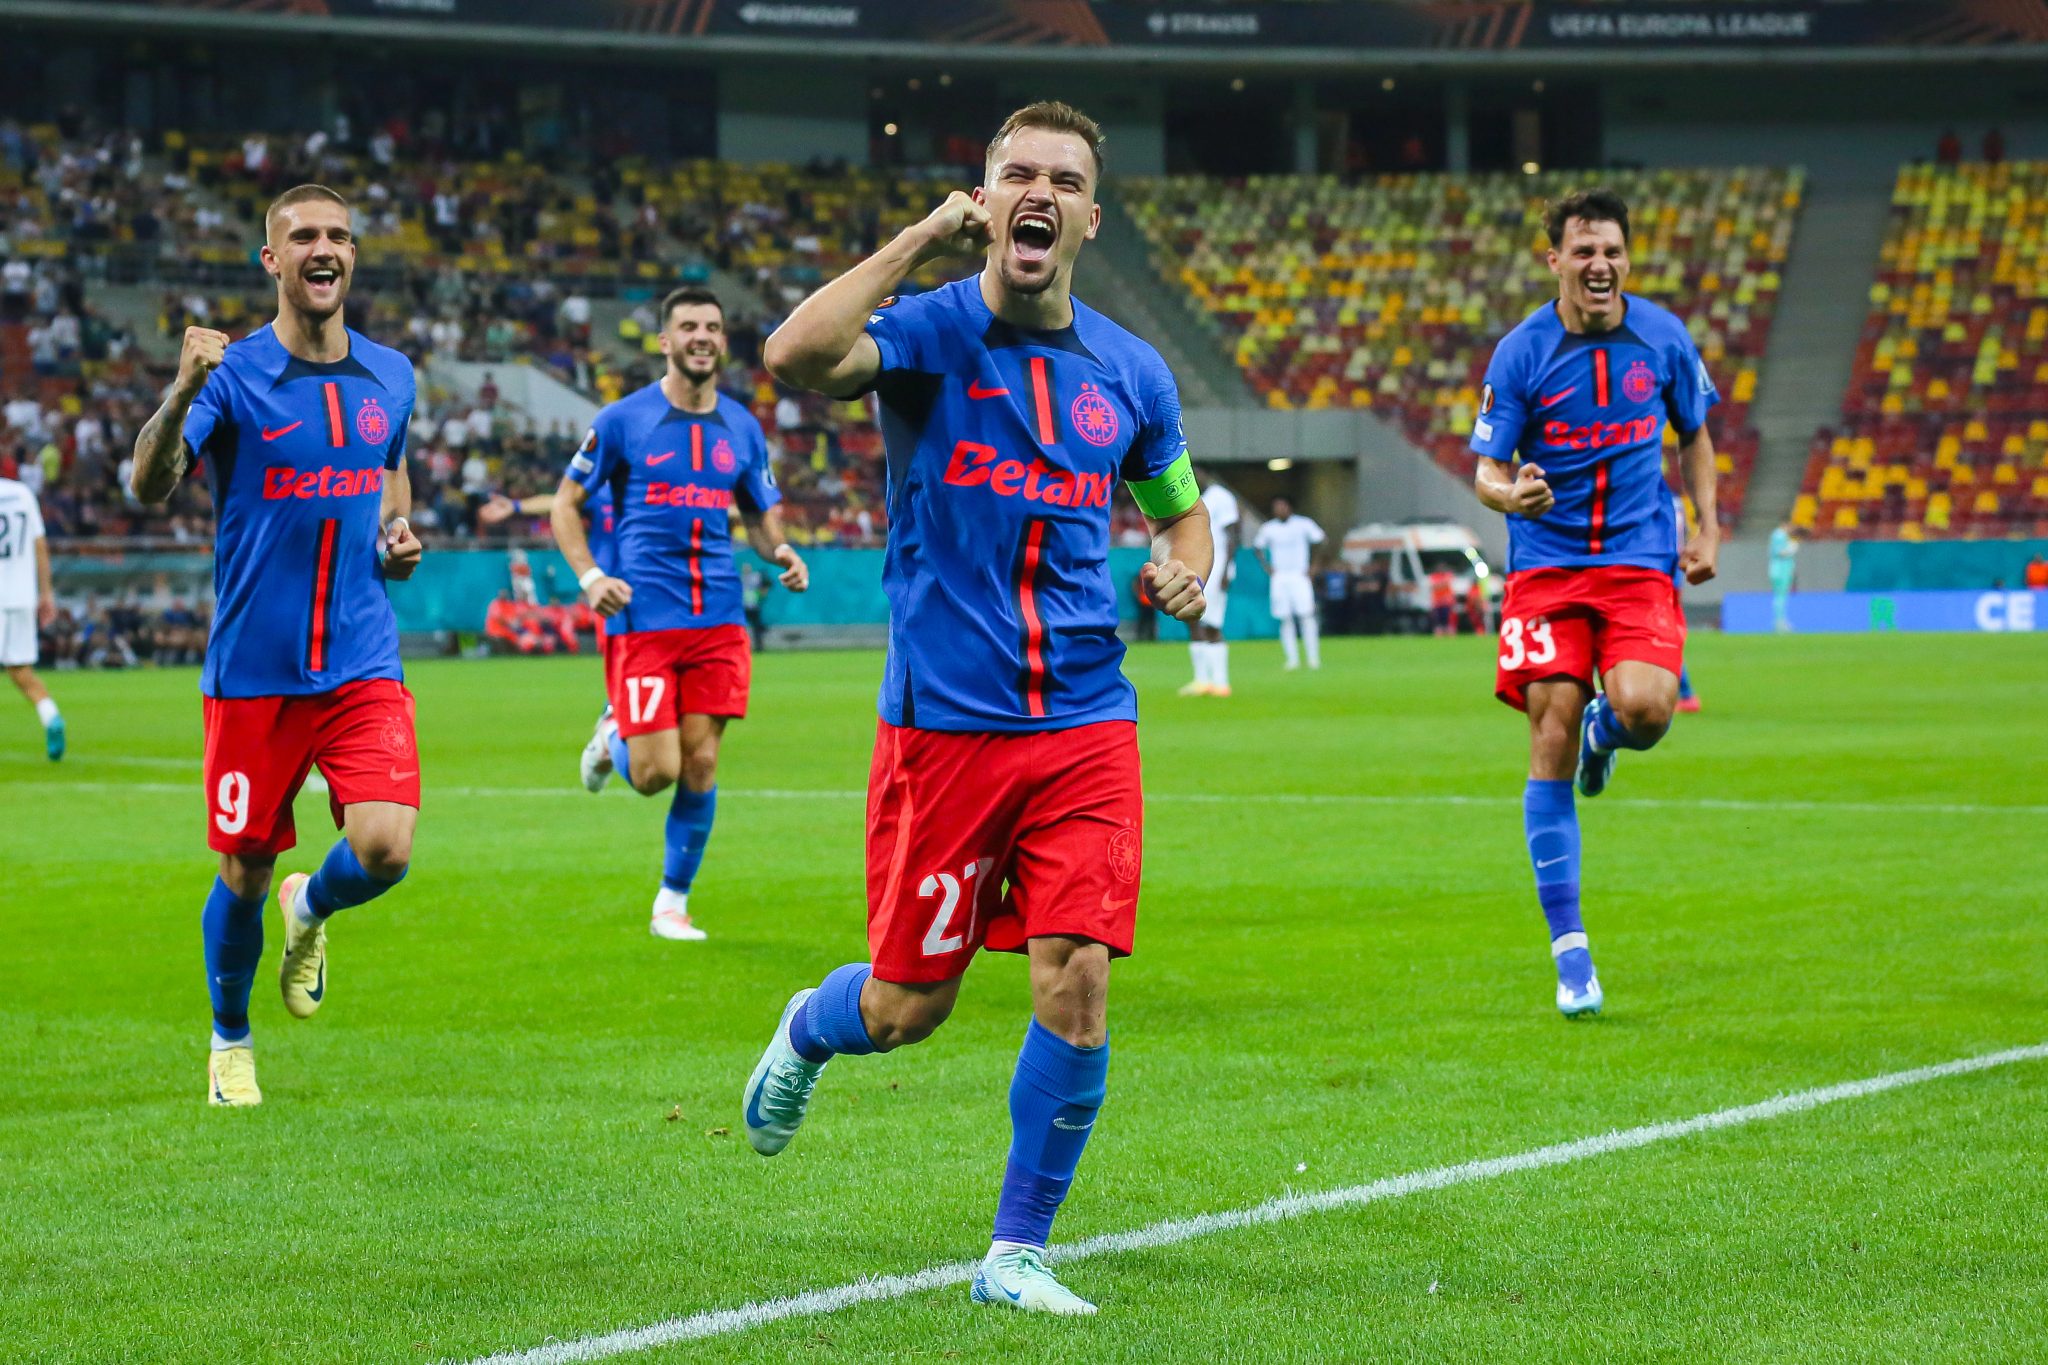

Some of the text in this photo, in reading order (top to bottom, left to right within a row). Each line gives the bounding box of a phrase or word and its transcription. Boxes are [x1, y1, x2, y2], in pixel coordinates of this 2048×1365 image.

[1550, 13, 1810, 37] UEFA EUROPA LEAGUE
[1544, 415, 1658, 449] Betano
[1499, 615, 1557, 671] 33
[626, 676, 665, 723] 17
[215, 771, 250, 835] 9
[918, 857, 995, 956] 27
